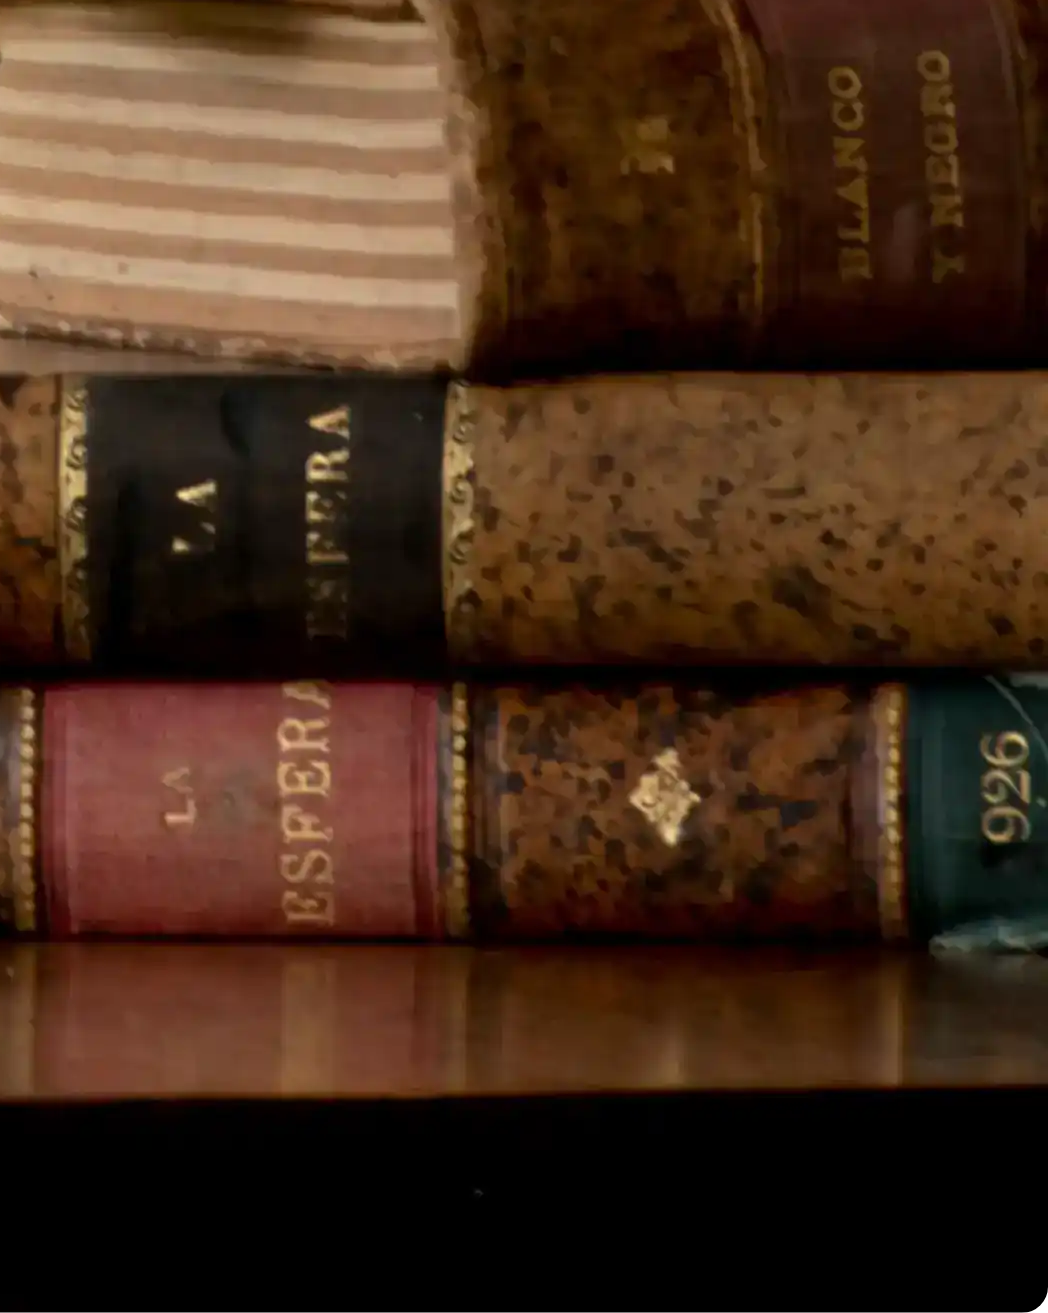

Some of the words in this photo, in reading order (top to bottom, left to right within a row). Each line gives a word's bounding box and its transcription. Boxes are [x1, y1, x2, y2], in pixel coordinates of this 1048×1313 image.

[827, 66, 874, 283] BLANCO
[916, 49, 965, 228] NEGRO
[930, 248, 965, 284] Y
[161, 766, 198, 827] LA
